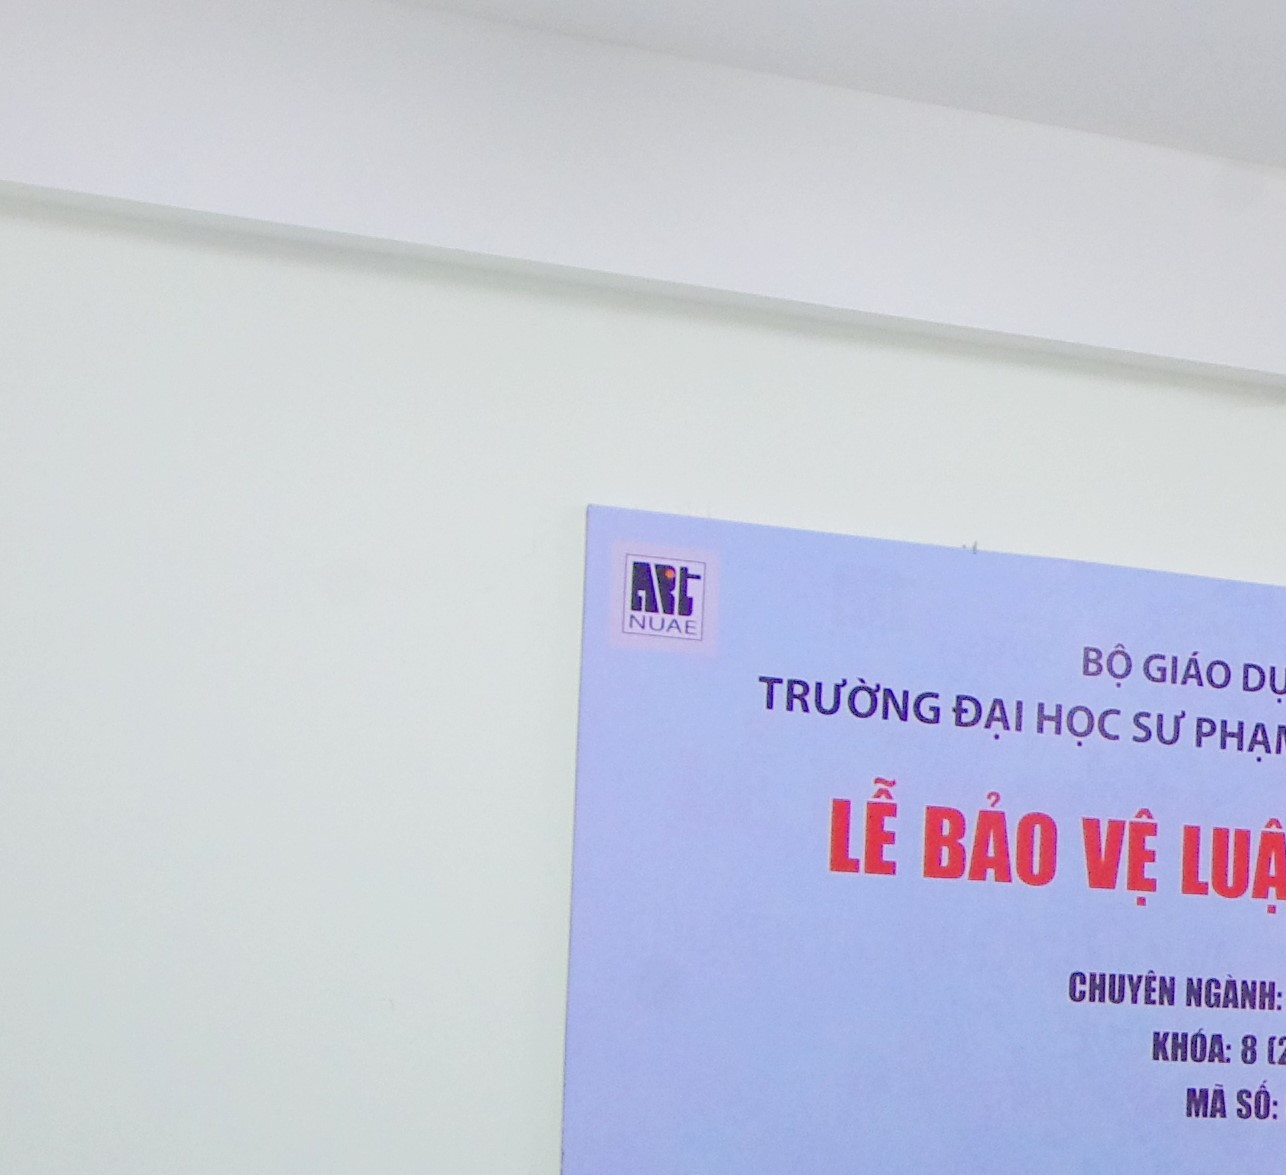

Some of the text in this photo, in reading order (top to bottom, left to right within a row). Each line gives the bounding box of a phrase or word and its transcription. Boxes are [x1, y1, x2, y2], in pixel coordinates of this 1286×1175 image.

[628, 613, 698, 636] NUAE
[1082, 643, 1133, 688] BỘ
[1142, 650, 1232, 690] GIÁO
[758, 675, 941, 725] TRƯỜNG
[951, 694, 1024, 740] ĐẠI
[1036, 702, 1121, 747] HỌC
[1132, 710, 1186, 746] SƯ
[830, 777, 898, 876] LỄ
[923, 791, 1058, 887] BẢO
[1082, 808, 1159, 906] VỆ
[1068, 969, 1176, 1007] CHUYÊN
[1185, 974, 1283, 1011] NGÀNH:
[1152, 1027, 1232, 1064] KHÓA:
[1240, 1034, 1258, 1065] 8
[1185, 1083, 1227, 1119] MÃ
[1236, 1080, 1279, 1120] SỐ:
